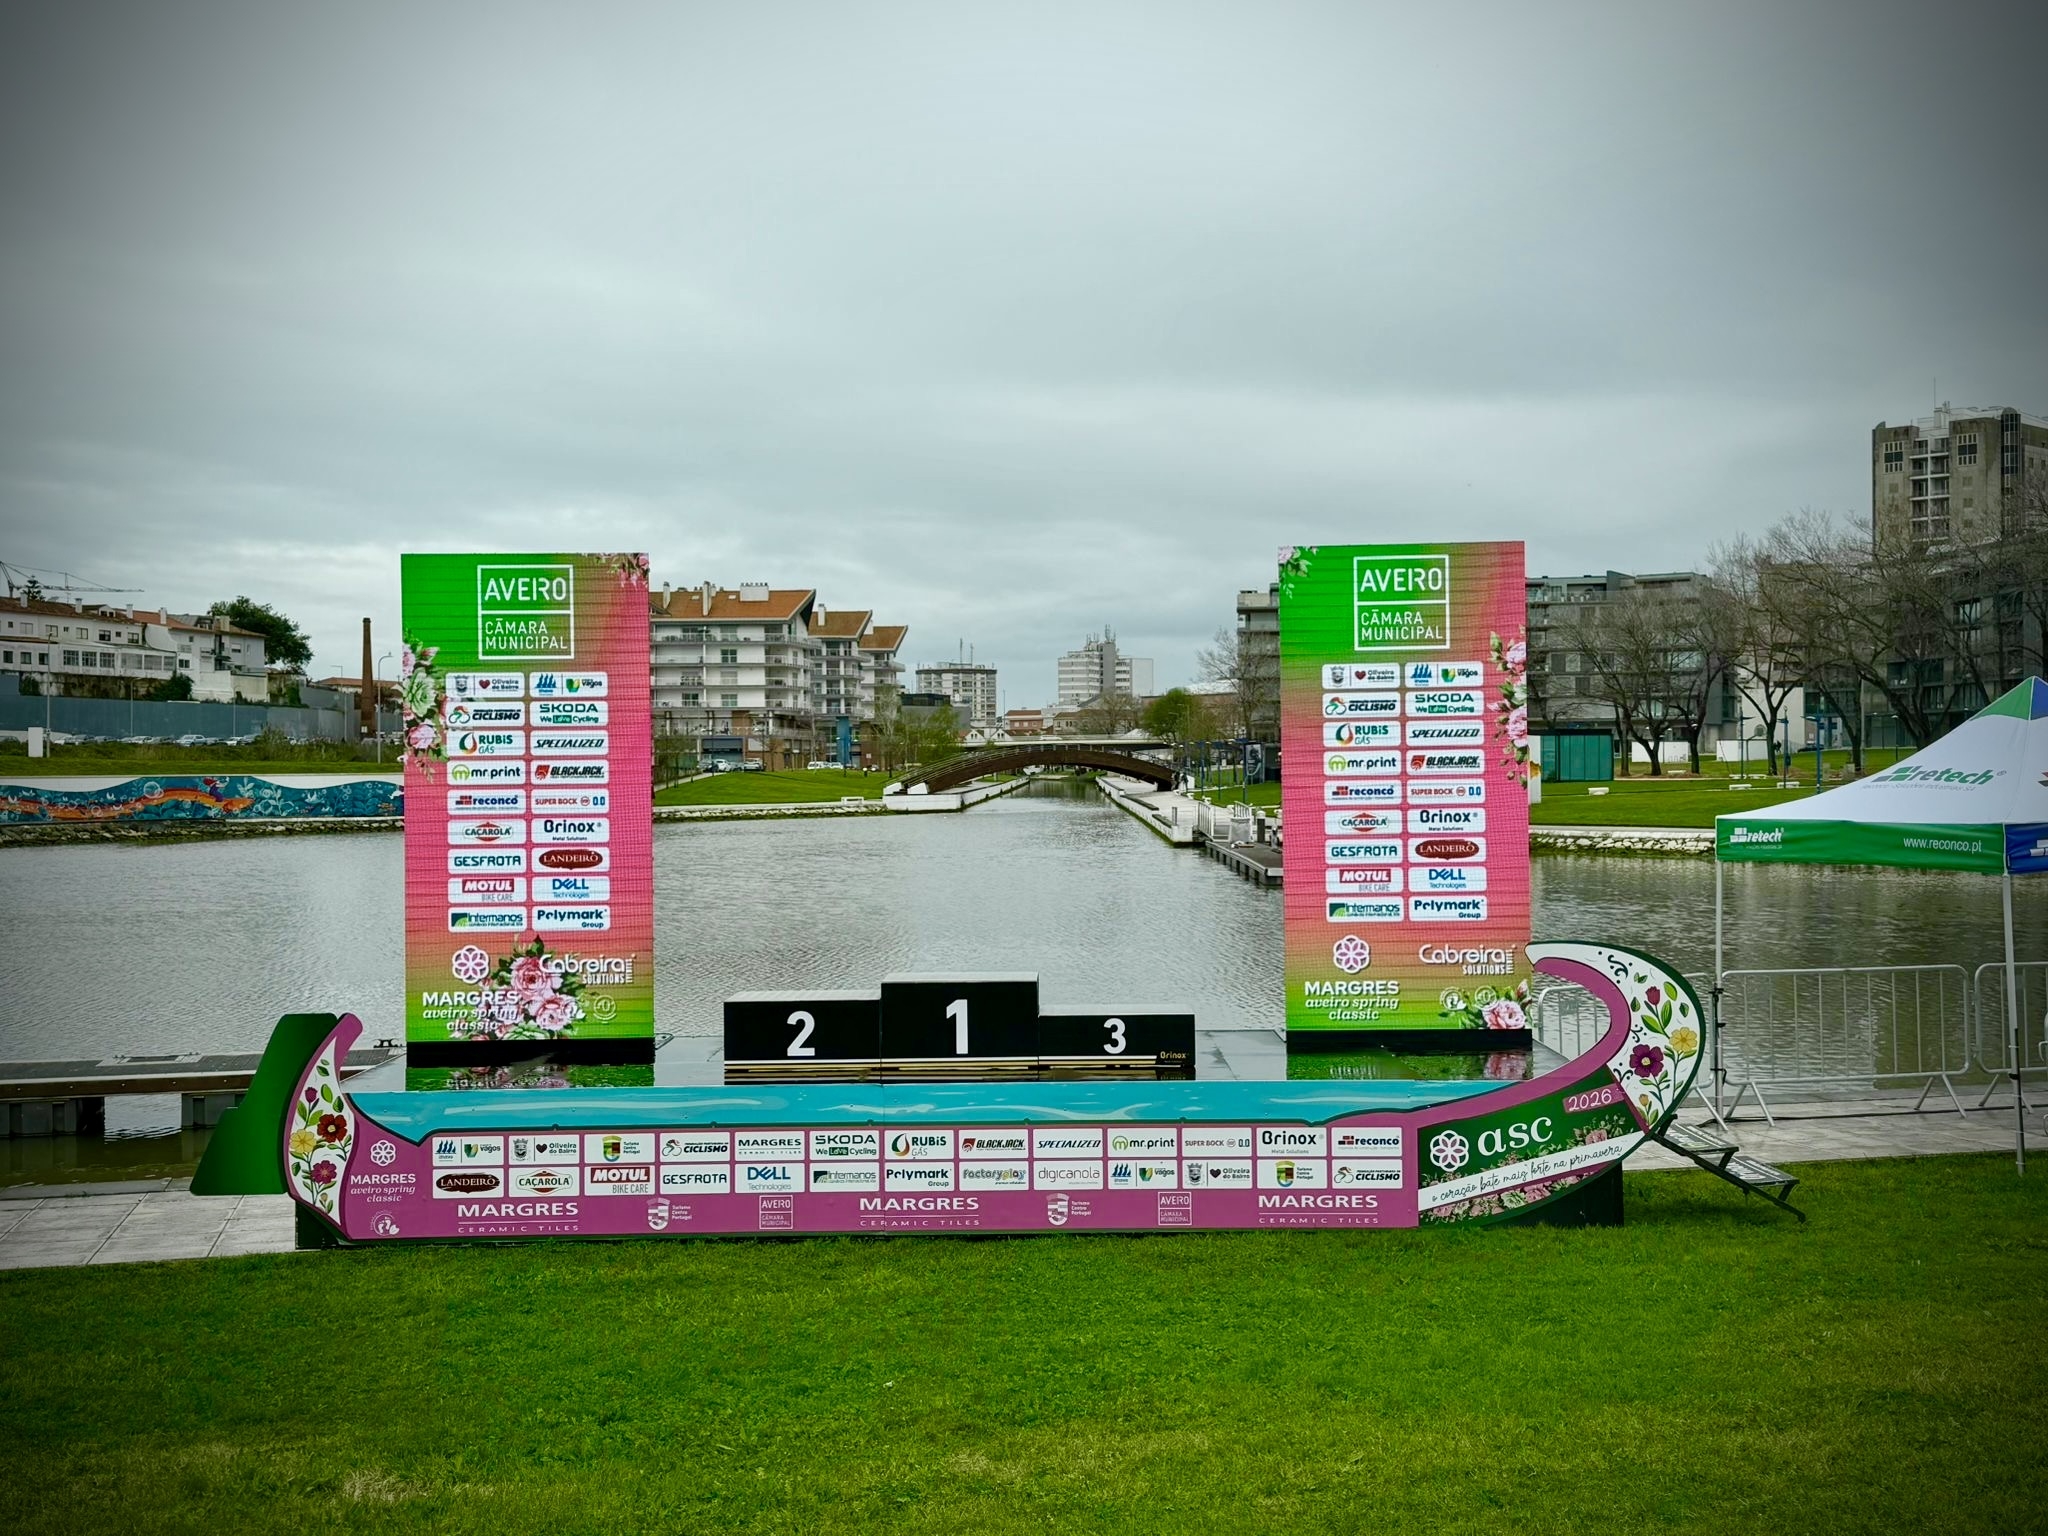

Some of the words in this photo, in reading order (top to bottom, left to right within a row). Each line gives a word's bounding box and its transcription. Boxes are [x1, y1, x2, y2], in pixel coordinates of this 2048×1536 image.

[1360, 568, 1443, 592] AVEIRO
[484, 577, 567, 601] AVEIRO
[1361, 626, 1443, 640] MUNICIPAL
[485, 636, 568, 650] MUNICIPAL
[1348, 702, 1396, 712] CICLISMO
[472, 712, 520, 720] CICLISMO
[1409, 728, 1480, 738] SPECIALIZED
[534, 738, 605, 749] SPECIALIZED
[1907, 768, 1995, 785] retech
[1349, 787, 1394, 796] reconco
[473, 796, 518, 805] reconco
[1746, 827, 1782, 843] retech
[1904, 837, 1982, 852] www.reconco.pt
[1332, 846, 1397, 857] GESFROTA
[454, 856, 521, 866] GESFROTA
[1341, 871, 1389, 881] MOTUL
[1429, 869, 1466, 880] DELL
[464, 881, 512, 891] MOTUL
[552, 878, 589, 890] DELL
[1359, 884, 1372, 892] BIKE
[1374, 884, 1390, 892] CARE
[482, 894, 495, 902] BIKE
[497, 894, 513, 902] CARE
[1414, 899, 1480, 911] Polymark
[537, 909, 603, 921] Polymark
[1419, 944, 1505, 963] Cabreira
[539, 954, 625, 973] Cabreira
[1462, 964, 1505, 975] SOLUTIONS
[582, 974, 624, 984] SOLUTIONS
[1305, 981, 1399, 996] MARGRES
[422, 991, 520, 1006] MARGRES
[1305, 998, 1349, 1008] aveiro
[1352, 996, 1399, 1009] spring
[423, 1008, 468, 1019] aveiro
[471, 1006, 519, 1020] spring
[1329, 1009, 1380, 1020] classic
[946, 998, 969, 1054] 1
[787, 1011, 815, 1057] 2
[1103, 1018, 1126, 1054] 3
[1568, 1088, 1612, 1112] 2026
[1478, 1116, 1553, 1156] asc
[738, 1138, 801, 1147] MARGRES
[1038, 1140, 1101, 1149] SPECIALIZED
[1129, 1138, 1174, 1149] mr.print
[480, 1146, 501, 1154] vagos
[684, 1145, 728, 1153] CICLISMO
[850, 1148, 876, 1156] Cycling
[592, 1169, 647, 1181] MOTUL
[747, 1166, 791, 1181] DELL
[886, 1168, 948, 1181] Polymark
[1038, 1167, 1100, 1182] digicanola
[1440, 1184, 1477, 1201] coração
[1480, 1174, 1500, 1192] bate
[1503, 1170, 1527, 1184] mais
[1529, 1162, 1551, 1179] forte
[1553, 1160, 1568, 1168] na
[1570, 1144, 1622, 1170] primavera
[350, 1174, 416, 1185] MARGRES
[519, 1177, 570, 1187] CAÇAROLA
[662, 1174, 727, 1184] GESFROTA
[383, 1184, 415, 1195] spring
[612, 1185, 629, 1194] BIKE
[630, 1184, 648, 1193] CARE
[748, 1183, 792, 1191] Technologies
[366, 1194, 402, 1202] classic
[1160, 1196, 1190, 1205] AVEIRO
[1258, 1195, 1378, 1208] MARGRES
[457, 1203, 578, 1217] MARGRES
[761, 1200, 791, 1209] AVEIRO
[859, 1198, 978, 1211] MARGRES
[458, 1225, 528, 1233] CERAMIC
